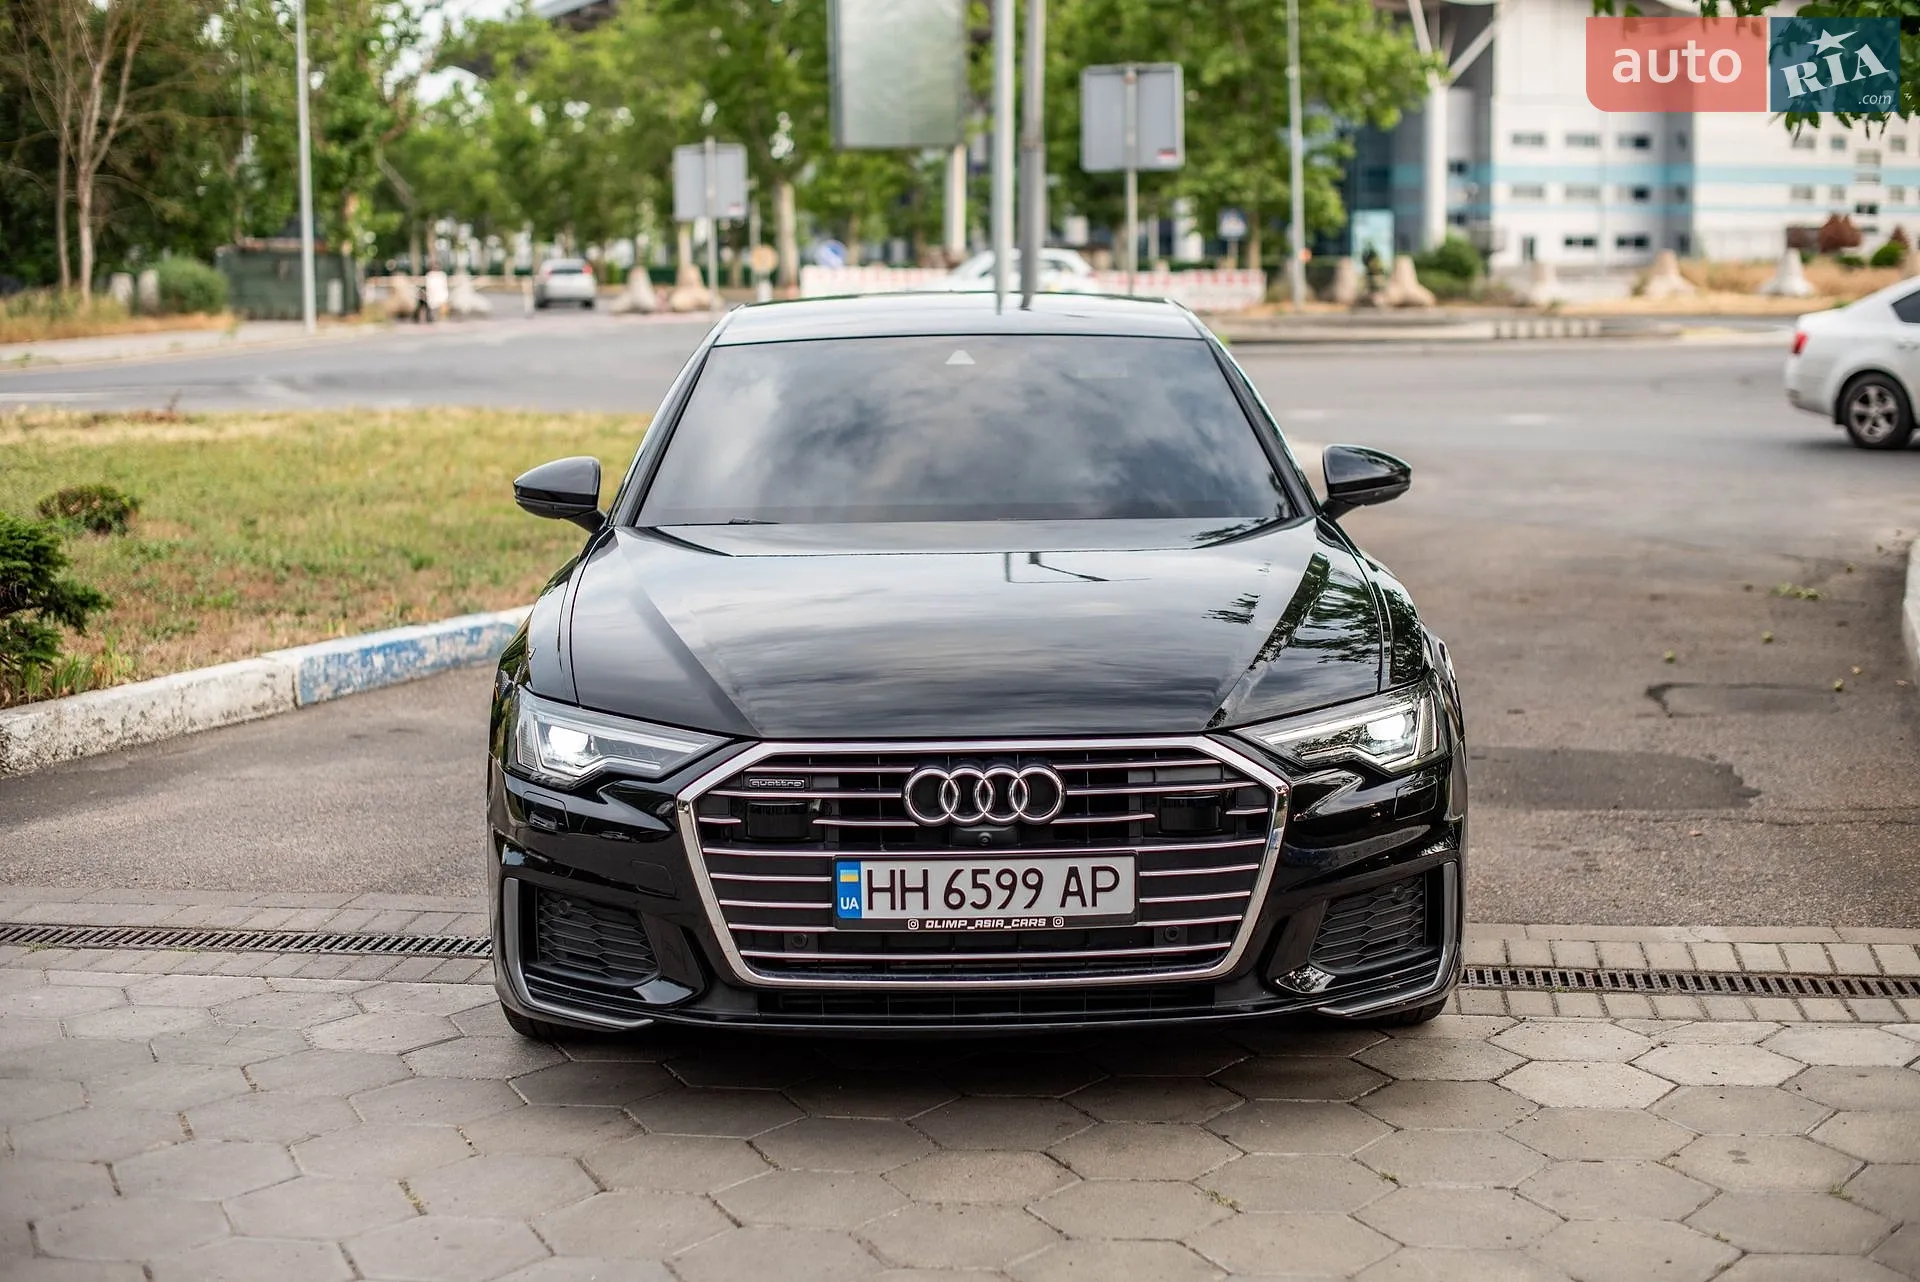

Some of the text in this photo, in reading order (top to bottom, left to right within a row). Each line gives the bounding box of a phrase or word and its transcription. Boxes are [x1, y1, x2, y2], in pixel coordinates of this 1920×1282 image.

[751, 780, 802, 788] quattro
[866, 865, 1121, 911] HH 6599 AP
[840, 897, 860, 911] UA
[925, 918, 1047, 930] OLIMP_ASIA_CARS
